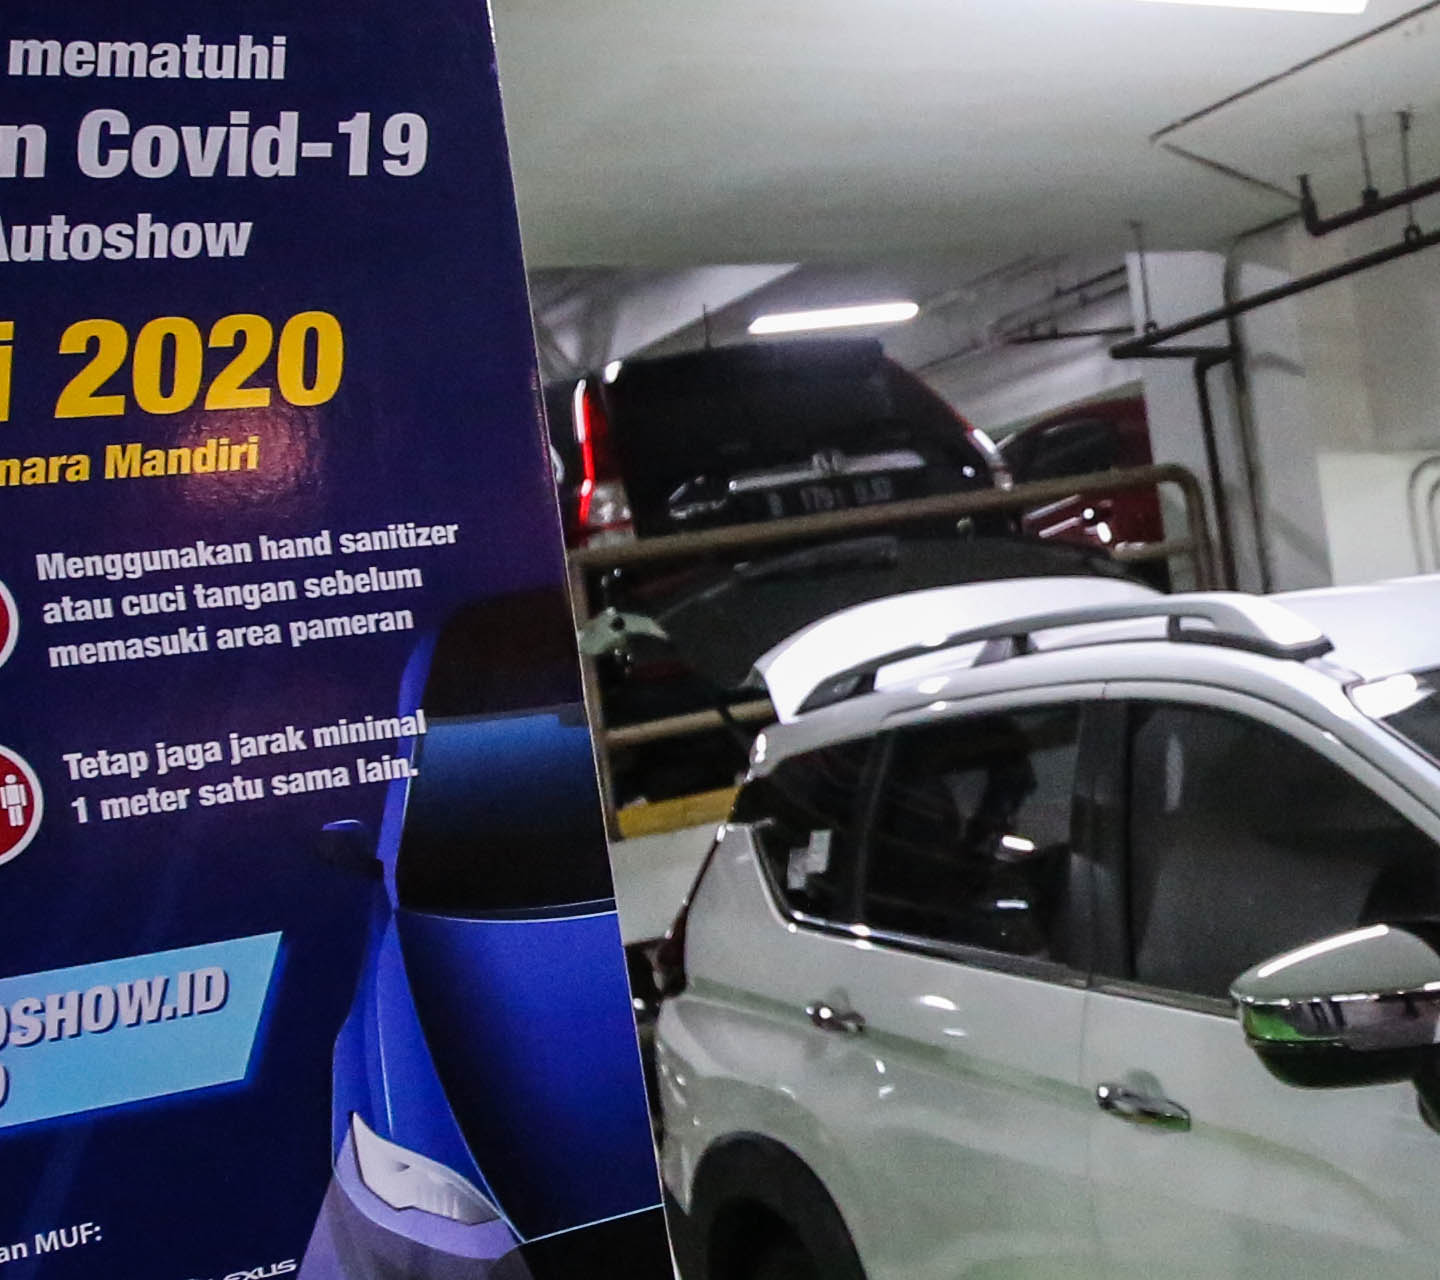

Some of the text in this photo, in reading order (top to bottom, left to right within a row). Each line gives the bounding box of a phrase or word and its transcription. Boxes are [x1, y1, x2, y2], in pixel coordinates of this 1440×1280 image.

[6, 33, 286, 80] mematuhi
[76, 107, 428, 179] Covid-19
[53, 310, 344, 419] 2020
[103, 430, 264, 480] Mandiri
[34, 521, 459, 581] Menggunakan hand sanitizer
[41, 565, 423, 624] atau cuci tangan sebelum
[47, 609, 414, 668] memasuki area pameran
[61, 709, 427, 780] Tetap jaga jarak minimal
[70, 750, 419, 824] 1 meter satu sama lain.
[33, 1220, 103, 1255] MUF:
